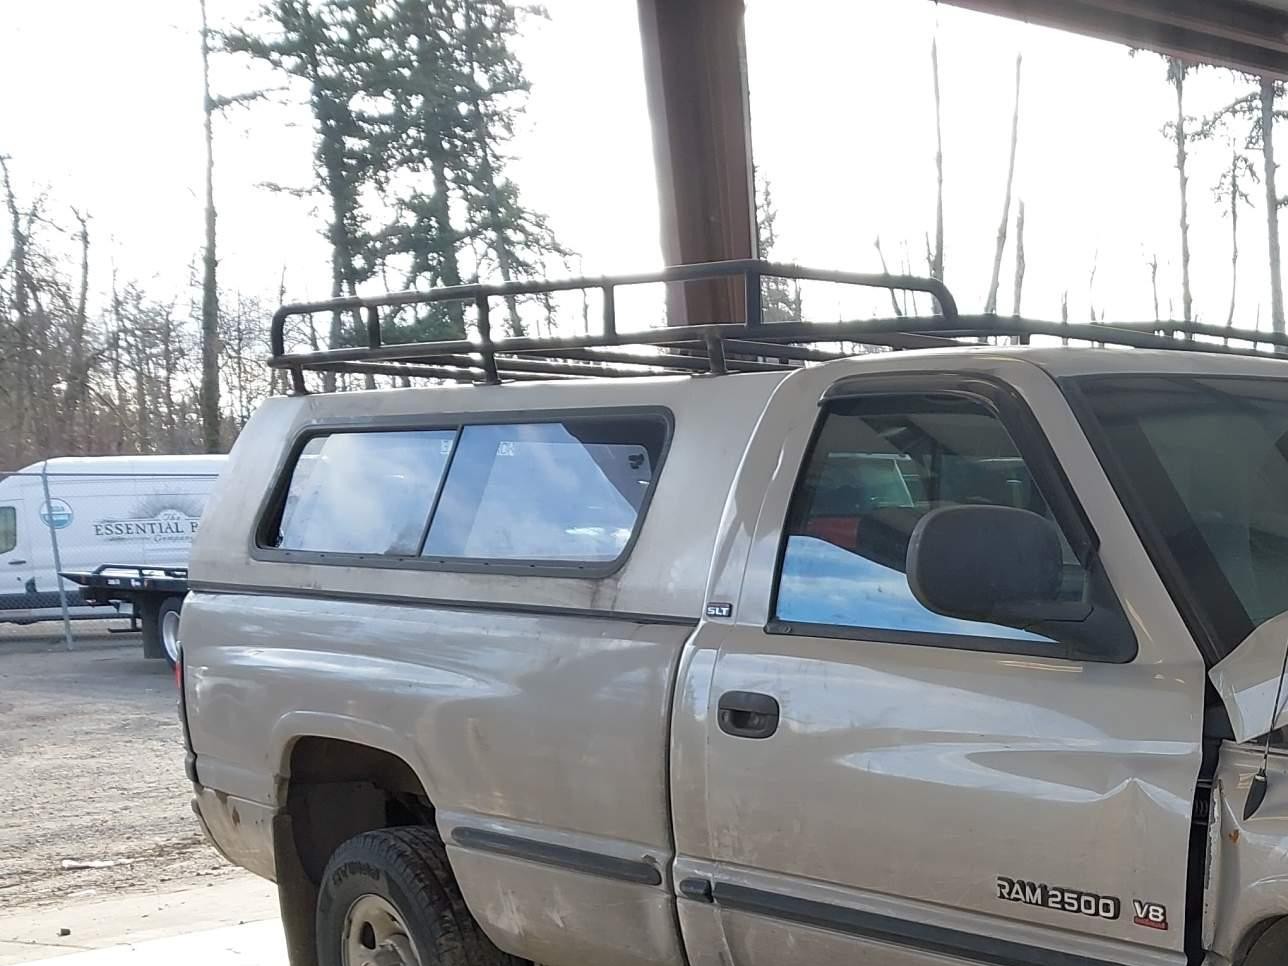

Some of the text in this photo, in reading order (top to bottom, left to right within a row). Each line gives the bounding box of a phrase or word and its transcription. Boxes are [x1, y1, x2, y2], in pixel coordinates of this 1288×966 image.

[94, 521, 184, 536] ESSENTIAL
[707, 607, 730, 616] SLT
[996, 877, 1120, 920] RAM 2500
[1133, 900, 1166, 923] V8
